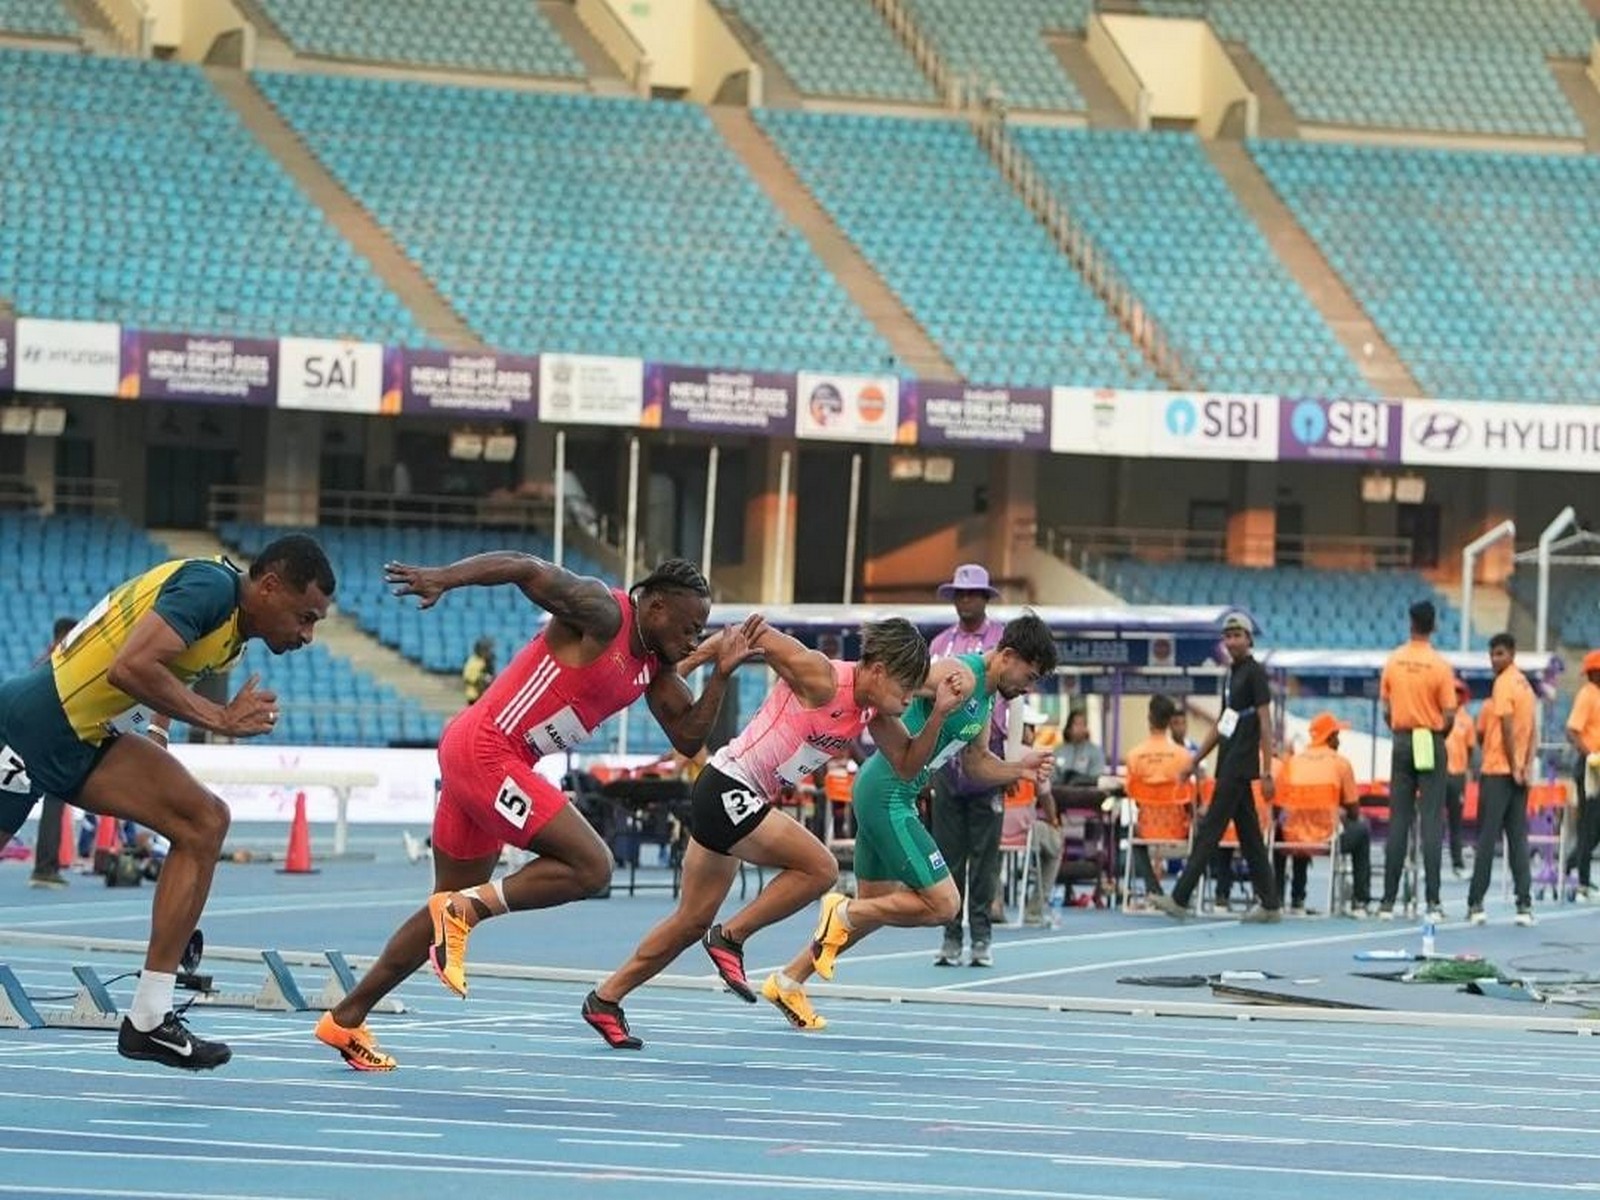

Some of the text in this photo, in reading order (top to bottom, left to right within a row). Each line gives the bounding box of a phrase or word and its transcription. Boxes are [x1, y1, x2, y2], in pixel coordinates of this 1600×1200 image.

[1203, 401, 1259, 438] SBI
[1327, 401, 1388, 447] SBI
[2, 756, 25, 786] 7
[499, 788, 526, 817] 5
[730, 792, 748, 816] 3
[348, 1036, 382, 1065] NITRO
